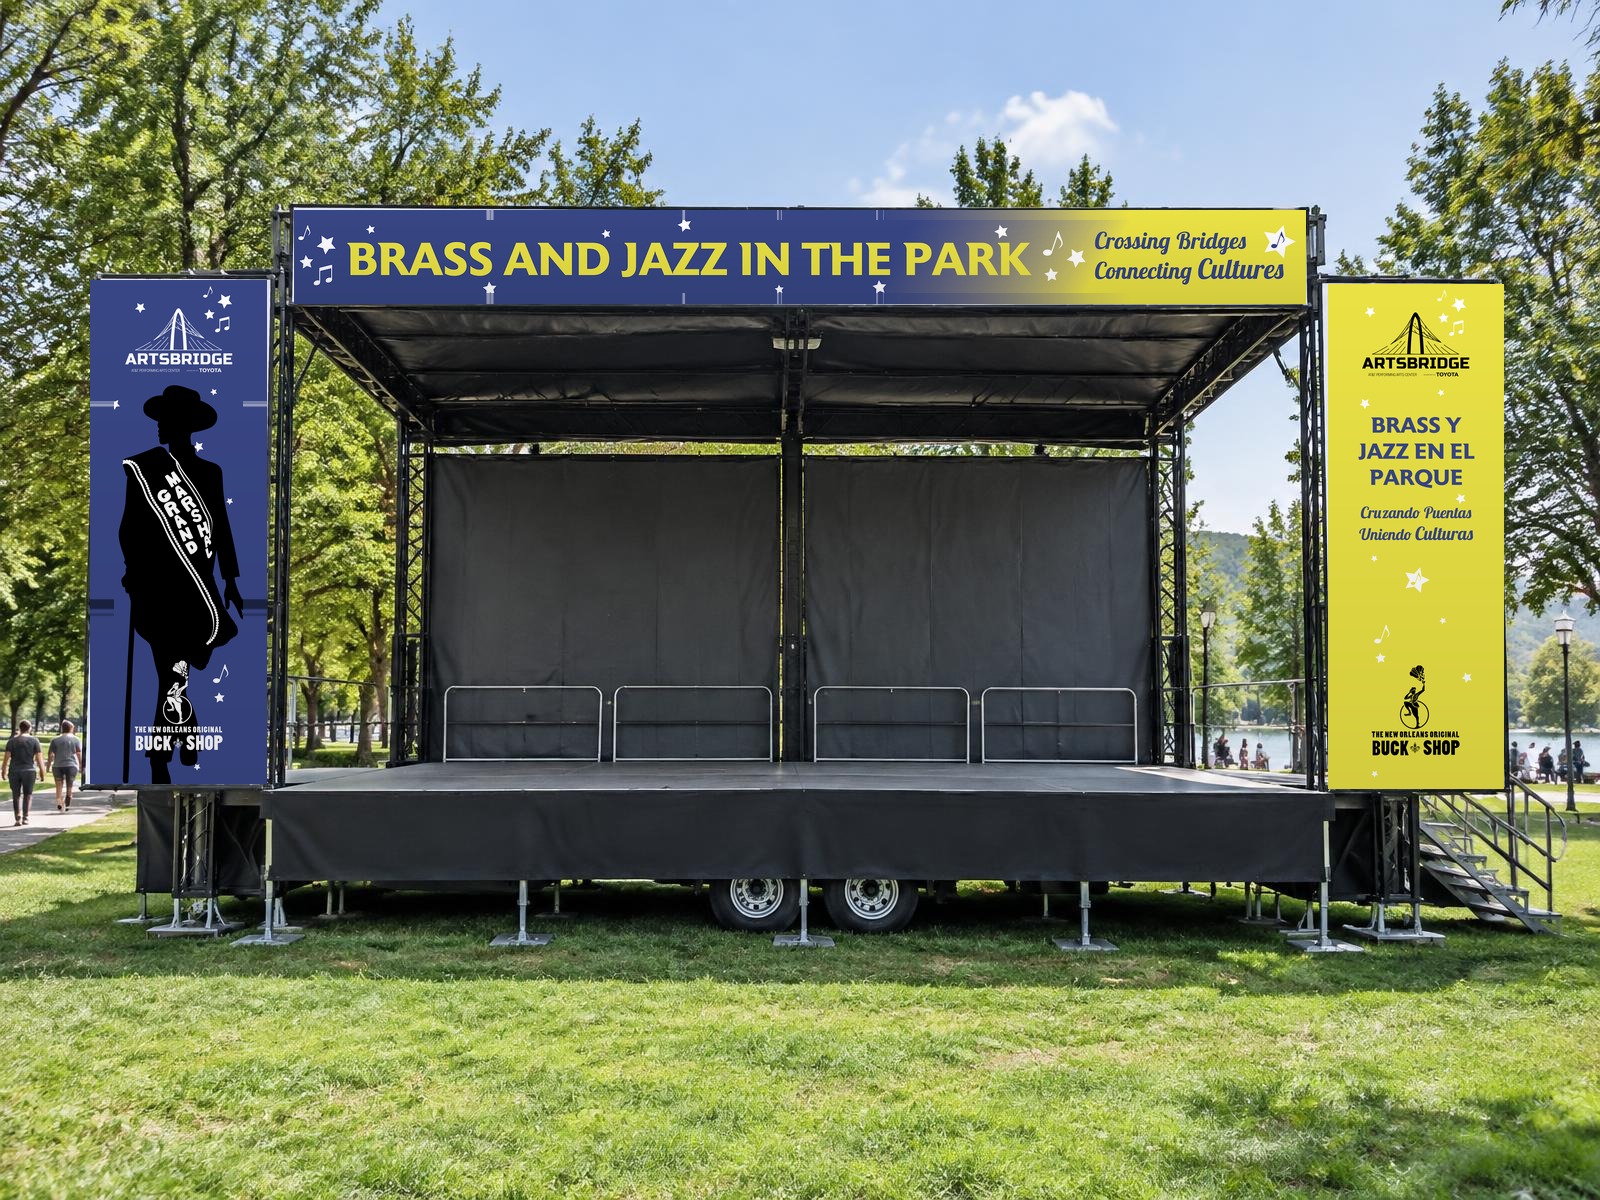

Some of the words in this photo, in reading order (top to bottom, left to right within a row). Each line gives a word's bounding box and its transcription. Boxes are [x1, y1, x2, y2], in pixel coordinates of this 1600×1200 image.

[1094, 231, 1170, 255] Crossing
[1176, 231, 1247, 255] Bridges
[347, 241, 493, 277] BRASS
[503, 241, 610, 276] AND
[620, 241, 728, 278] JAZZ
[739, 241, 790, 276] IN
[801, 241, 891, 276] THE
[903, 241, 1032, 276] PARK
[1094, 261, 1193, 285] Connecting
[1198, 257, 1285, 279] Cultures
[125, 353, 233, 365] ARTSBRIDGE
[1362, 357, 1470, 369] ARTSBRIDGE
[1371, 416, 1441, 433] BRASS
[1445, 416, 1462, 433] Y
[1358, 443, 1409, 460] JAZZ
[1414, 443, 1444, 459] EN
[1450, 443, 1475, 459] EL
[1370, 468, 1463, 488] PARQUE
[1360, 506, 1420, 519] Cruzando
[1423, 506, 1472, 519] Puentas
[157, 489, 198, 555] GRAND
[1358, 527, 1412, 541] Uniendo
[1415, 525, 1474, 541] Culturas
[135, 735, 172, 751] BUCK
[186, 735, 224, 751] SHOP
[1372, 740, 1409, 756] BUCK
[1423, 740, 1460, 756] SHOP
